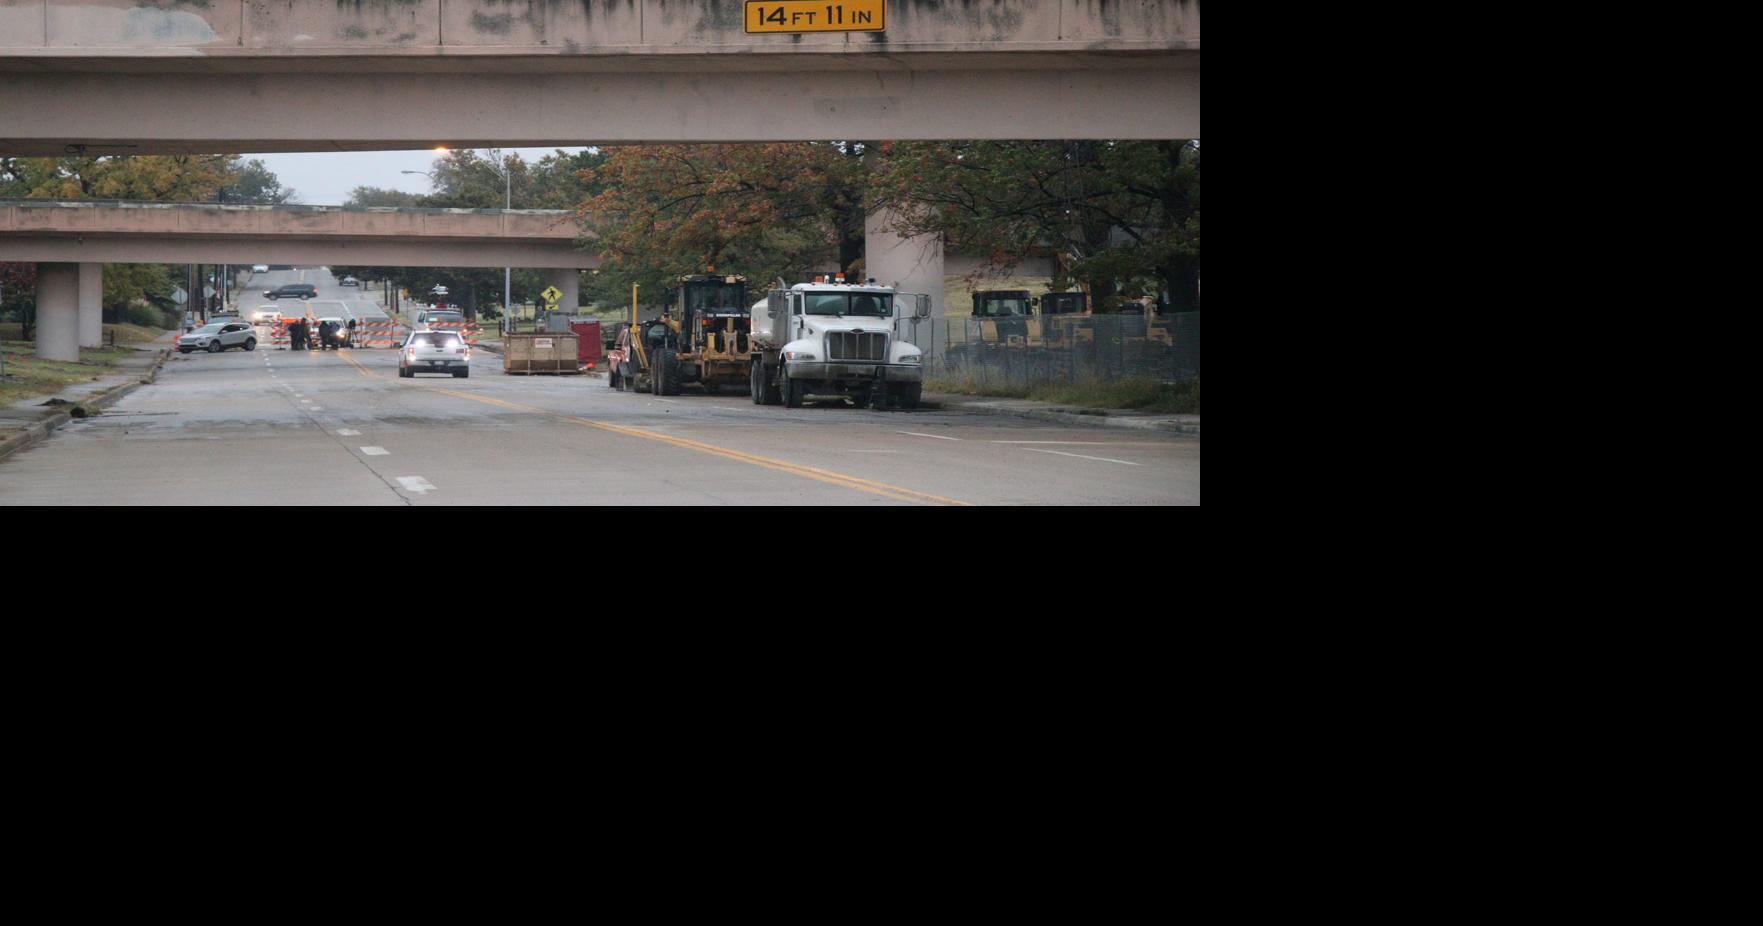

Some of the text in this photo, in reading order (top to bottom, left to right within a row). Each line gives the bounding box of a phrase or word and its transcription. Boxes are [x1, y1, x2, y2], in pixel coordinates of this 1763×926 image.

[758, 5, 871, 25] 14 FT 11 IN
